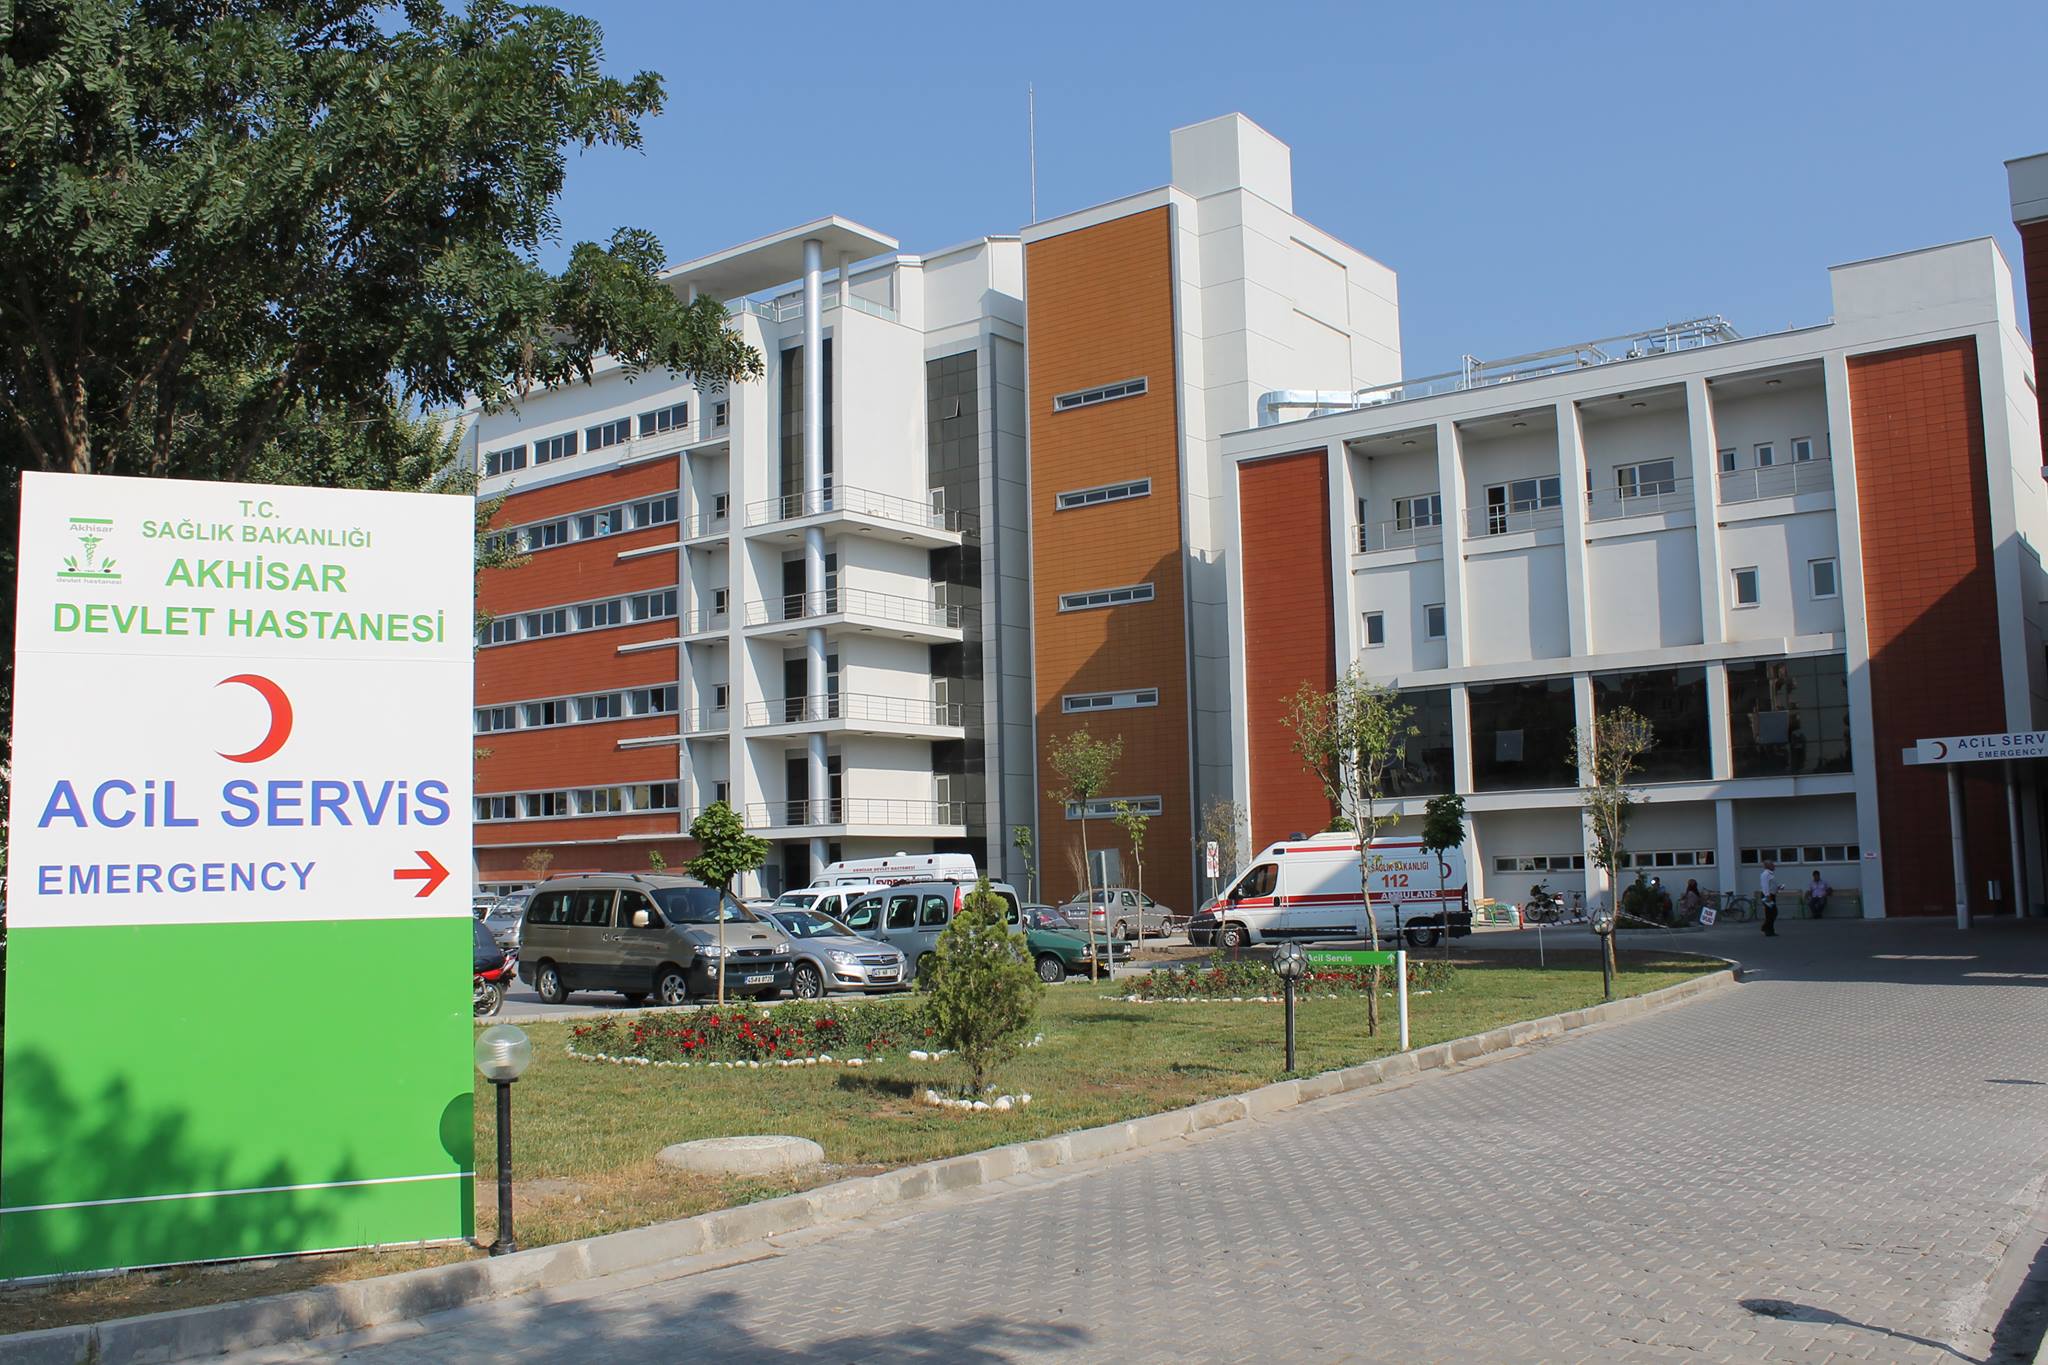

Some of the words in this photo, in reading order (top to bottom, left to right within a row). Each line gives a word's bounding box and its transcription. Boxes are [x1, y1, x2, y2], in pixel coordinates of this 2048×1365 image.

[239, 500, 280, 519] T.C.
[70, 523, 113, 533] Akhisar
[142, 518, 233, 543] SAĞLIK
[241, 525, 372, 549] BAKANLIĞI
[164, 555, 347, 593] AKHİSAR
[54, 603, 215, 637] DEVLET
[228, 609, 445, 643] HASTANESİ
[1978, 747, 2044, 759] EMERGENCY
[38, 861, 317, 895] EMERGENCY
[1382, 873, 1409, 888] 112
[1325, 953, 1353, 962] Servis
